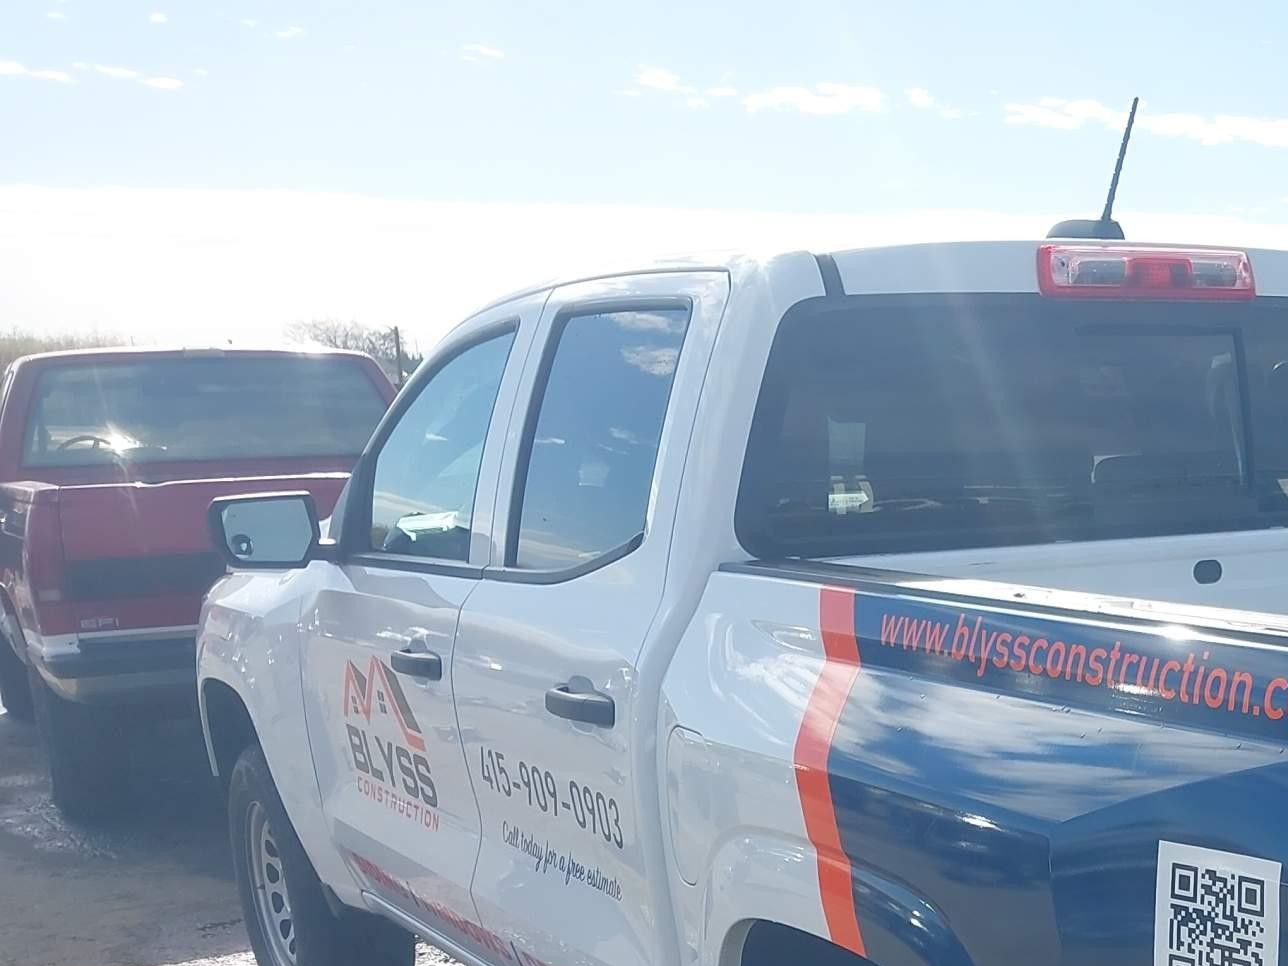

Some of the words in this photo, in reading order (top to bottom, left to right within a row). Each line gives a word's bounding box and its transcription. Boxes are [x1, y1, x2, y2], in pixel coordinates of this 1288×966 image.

[346, 723, 438, 808] BLYSS
[357, 775, 440, 832] CONSTRUCTION
[480, 746, 623, 849] 415-909-0903
[502, 820, 519, 849] Call
[520, 831, 543, 872] today
[543, 839, 557, 874] for
[559, 855, 565, 872] a
[565, 851, 585, 885] free
[587, 866, 622, 901] estimate
